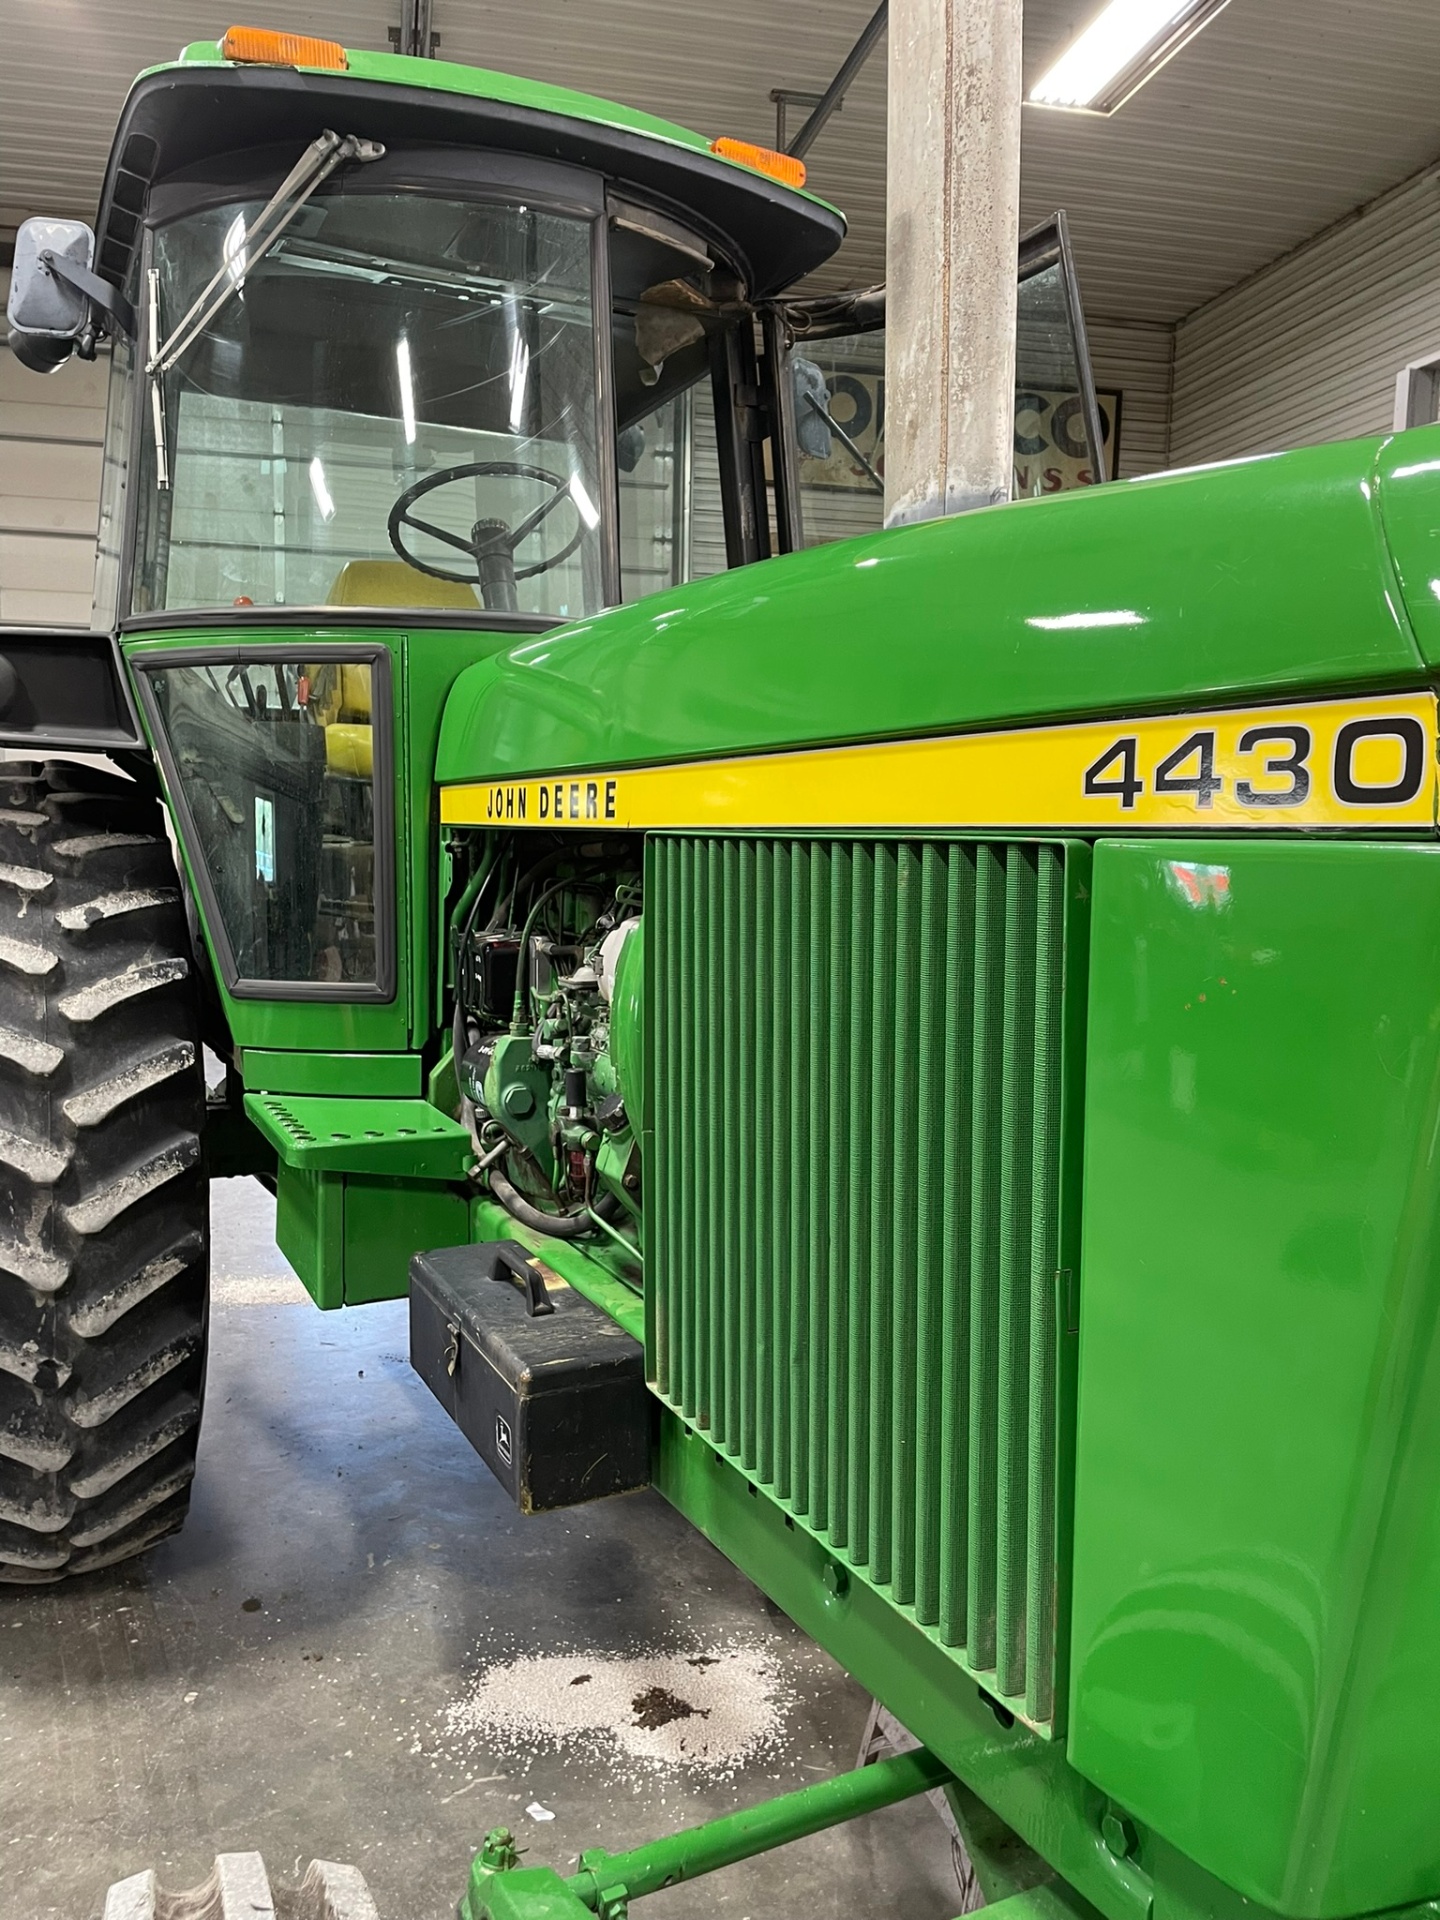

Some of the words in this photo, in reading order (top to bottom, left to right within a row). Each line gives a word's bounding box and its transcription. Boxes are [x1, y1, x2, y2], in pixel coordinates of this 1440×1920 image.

[1083, 716, 1426, 810] 4430
[487, 786, 527, 819] JOHN
[539, 780, 617, 819] DEERE
